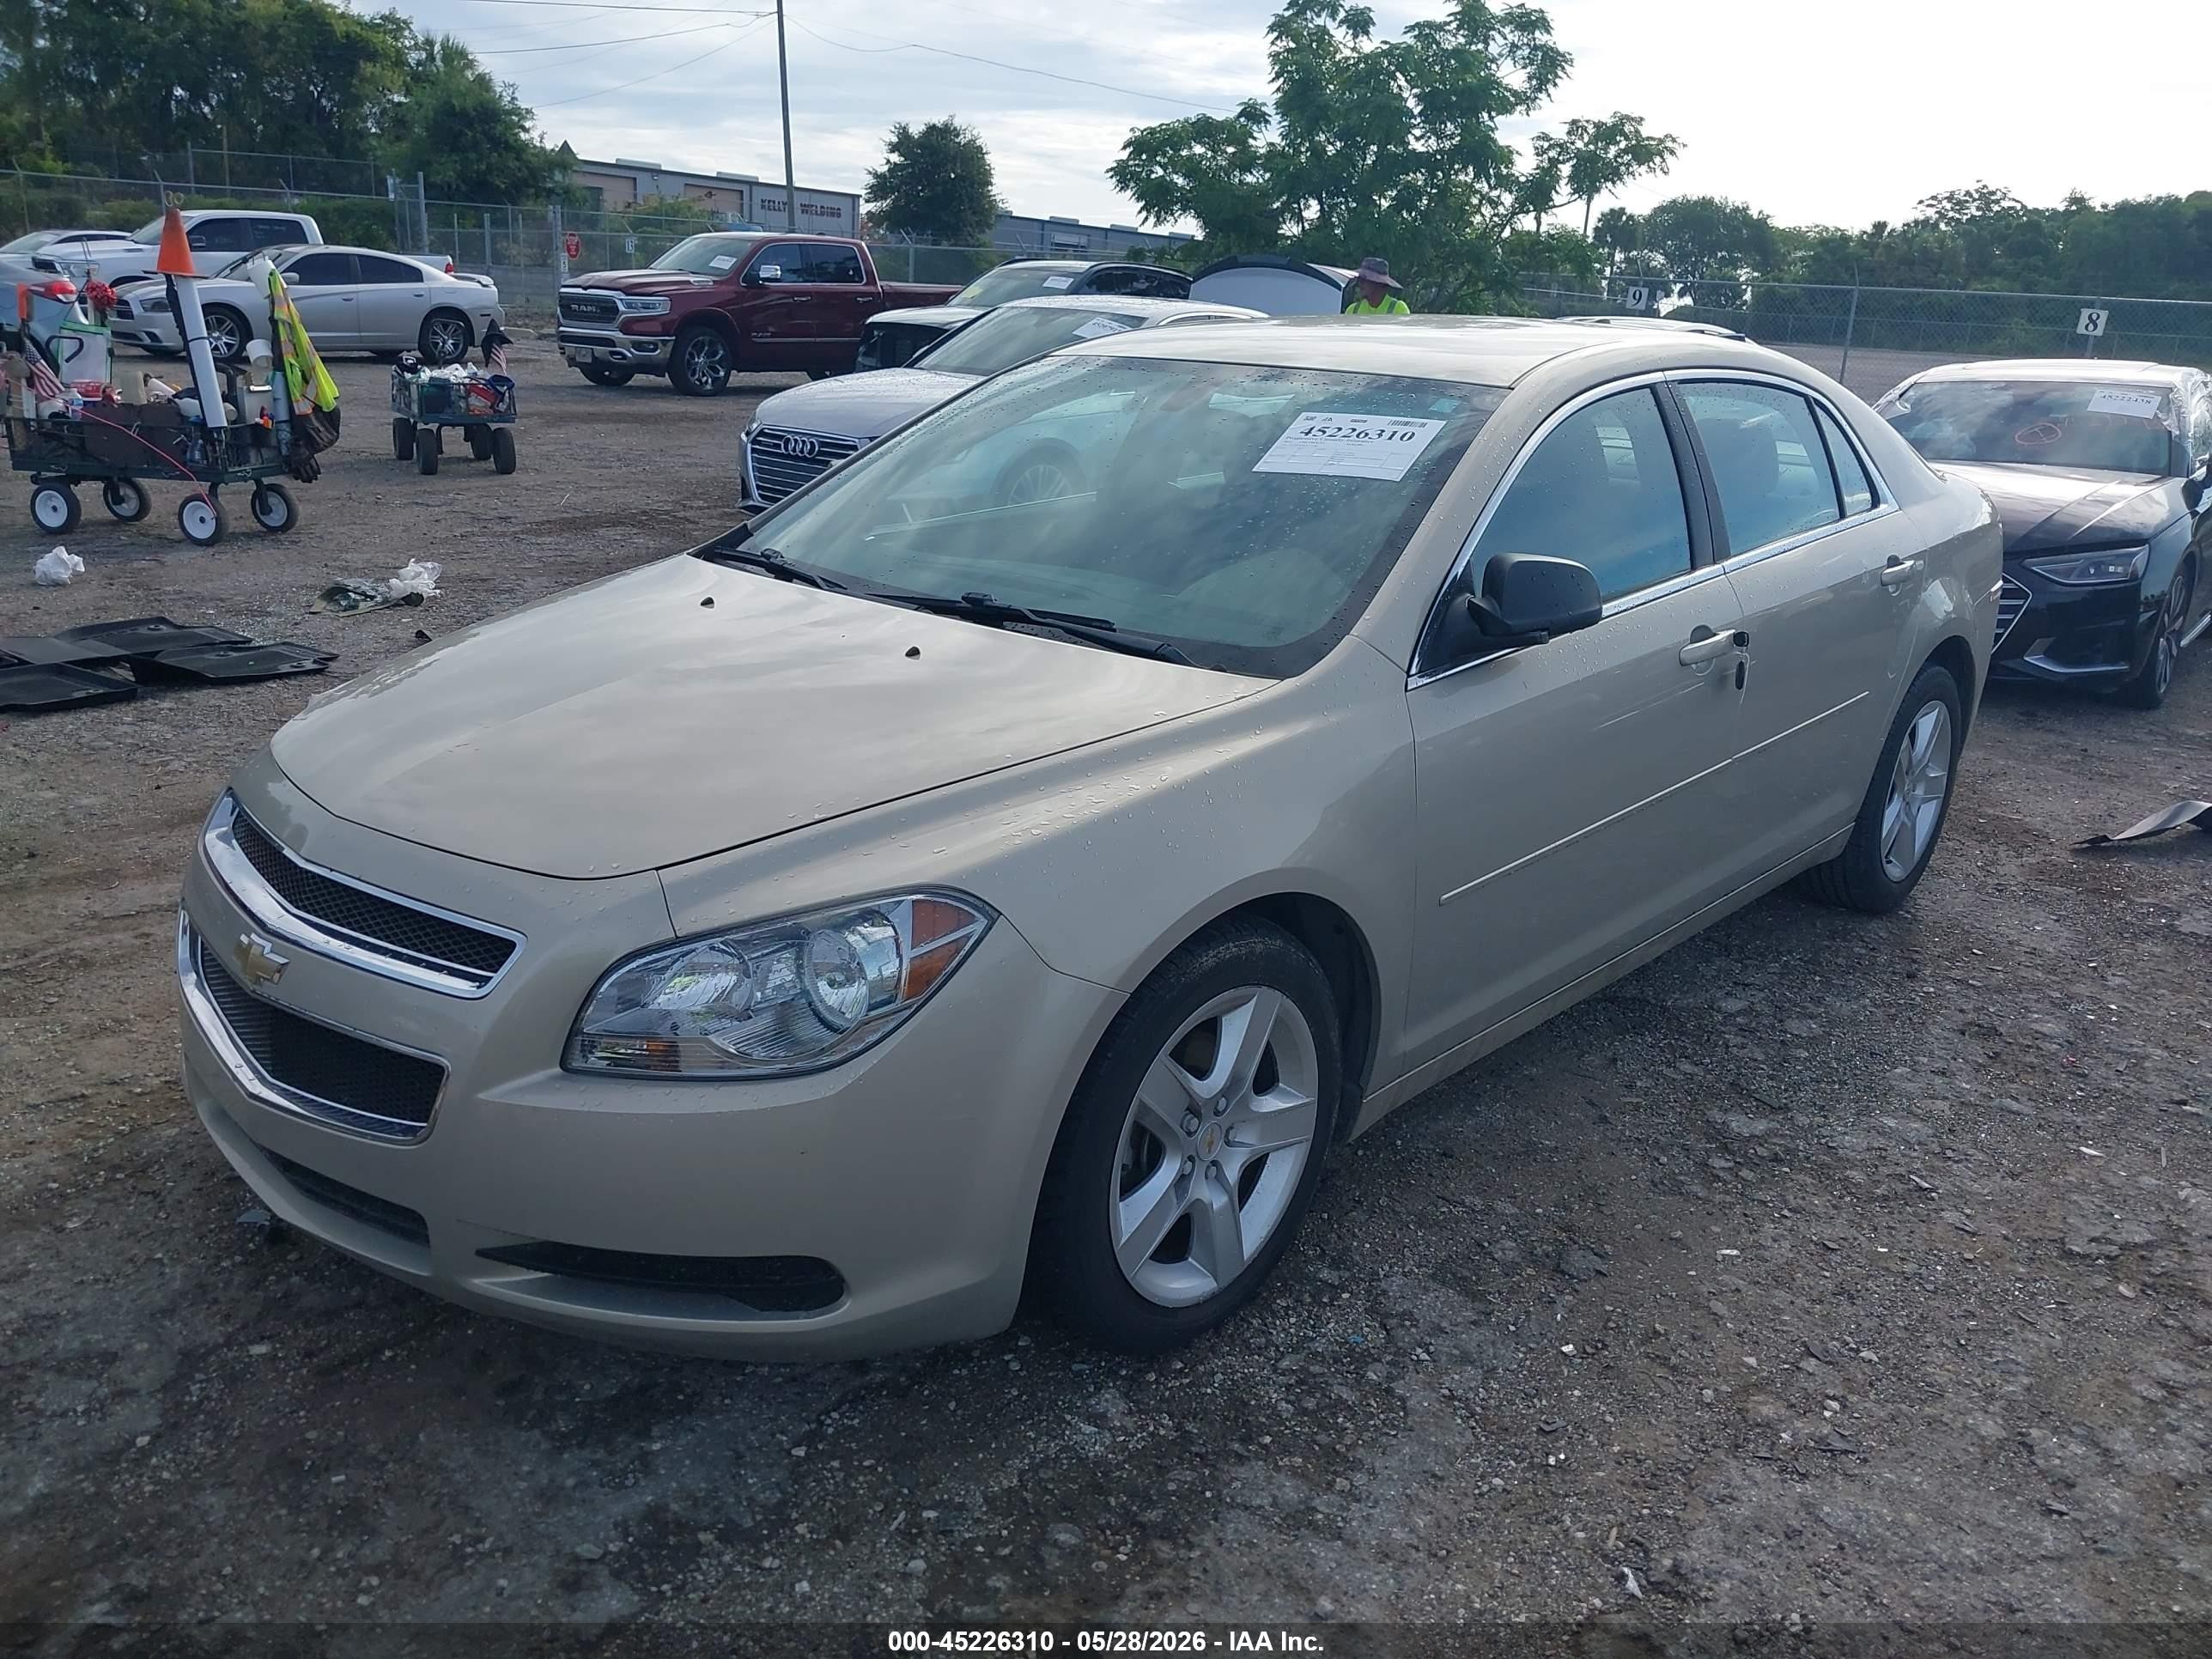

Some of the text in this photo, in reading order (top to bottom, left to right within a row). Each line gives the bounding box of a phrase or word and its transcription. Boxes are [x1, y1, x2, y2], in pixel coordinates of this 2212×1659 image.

[761, 198, 842, 219] KELLY WELDING
[1632, 289, 1643, 307] 9
[570, 304, 597, 313] RAM
[2084, 312, 2100, 332] 8
[1299, 425, 1417, 442] 45226310
